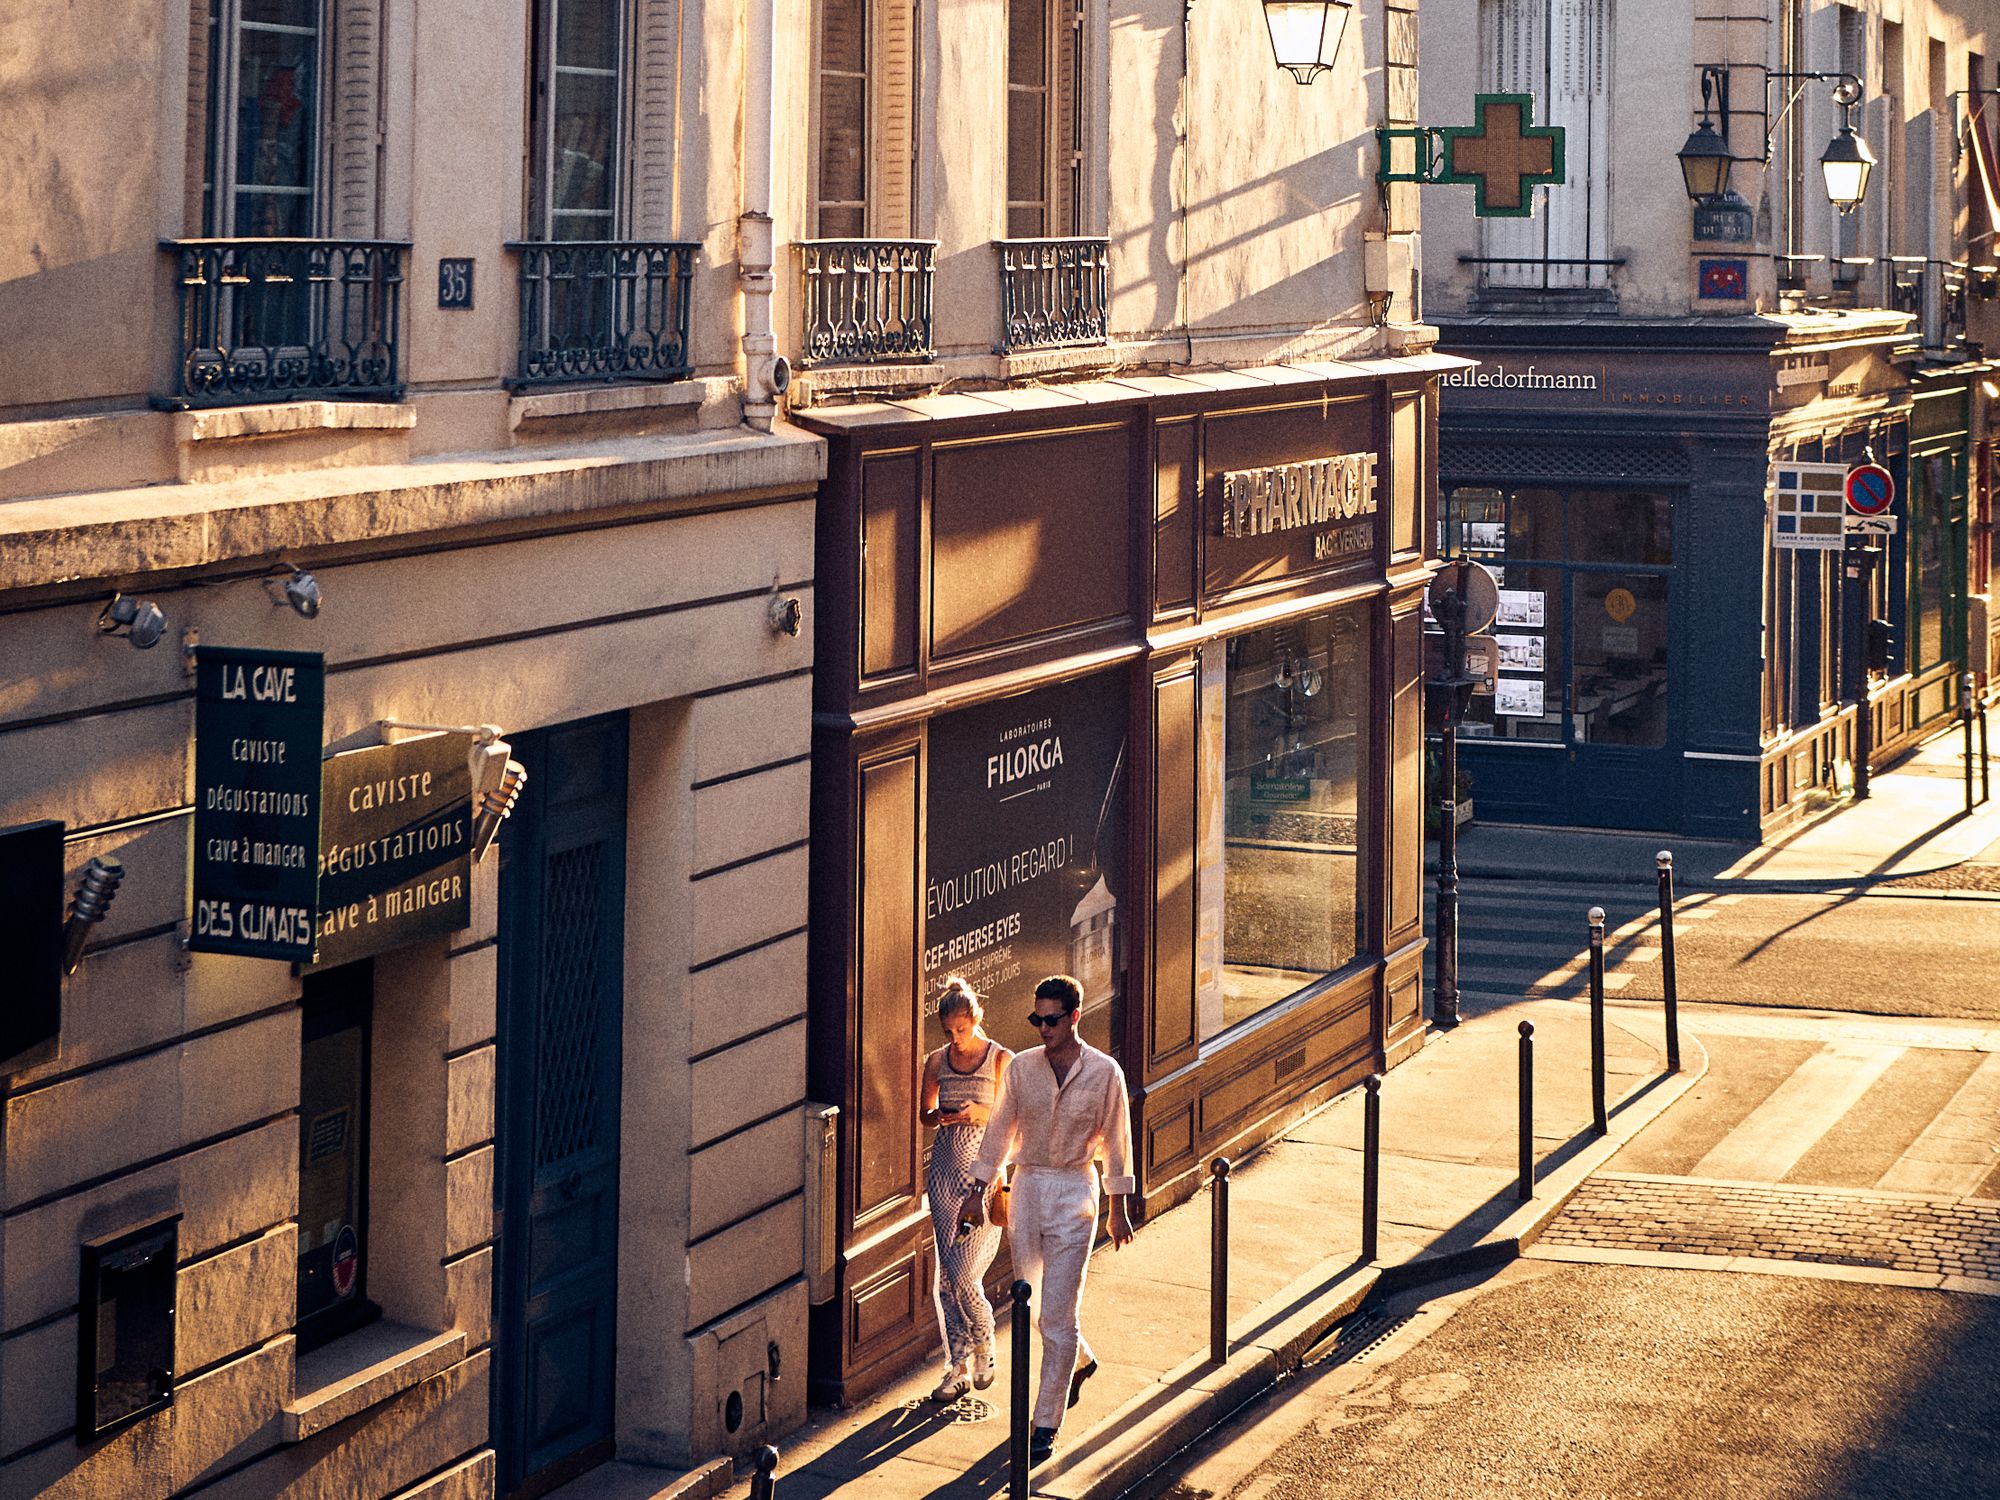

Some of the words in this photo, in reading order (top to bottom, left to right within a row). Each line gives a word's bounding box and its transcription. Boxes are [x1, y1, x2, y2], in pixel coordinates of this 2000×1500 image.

[443, 263, 467, 301] 35
[1611, 393, 1749, 405] IMMOBILIER
[1229, 452, 1378, 539] PHARMACIE
[1315, 534, 1333, 560] BAC
[222, 664, 247, 700] LA
[252, 665, 297, 703] CAVE
[1000, 717, 1052, 743] LABORATOIRES
[987, 736, 1064, 789] FILORGA
[1036, 780, 1051, 792] PARIS
[927, 859, 1007, 920] ÉVOLUTION
[1012, 837, 1066, 887] REGARD
[198, 899, 234, 938] DES
[239, 903, 311, 945] CLIMATS
[996, 912, 1021, 942] EYES
[981, 944, 1013, 972] SUPRÊME
[1000, 961, 1021, 983] JOURS
